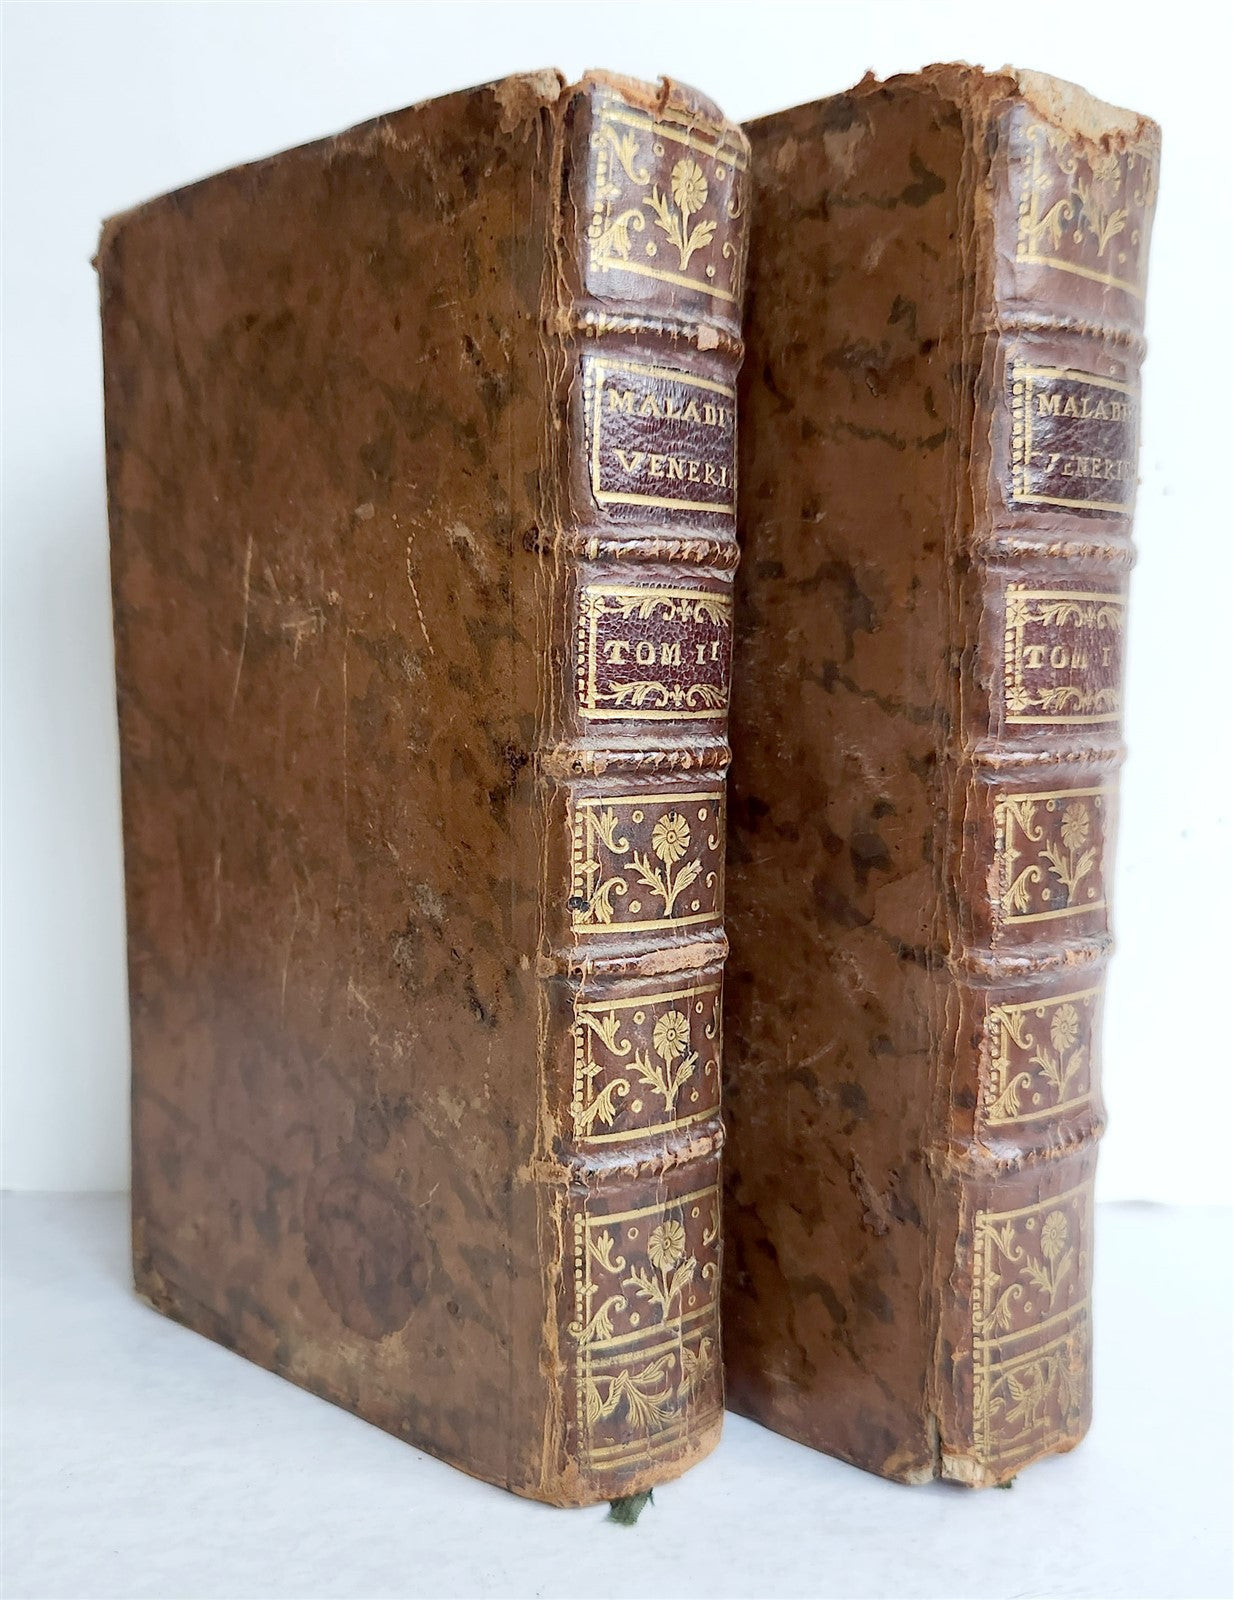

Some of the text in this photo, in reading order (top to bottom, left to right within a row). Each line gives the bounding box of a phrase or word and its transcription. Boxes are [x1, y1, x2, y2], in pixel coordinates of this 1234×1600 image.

[613, 448, 733, 489] VENERI
[603, 639, 720, 666] TOM II
[1022, 645, 1088, 669] TOM
